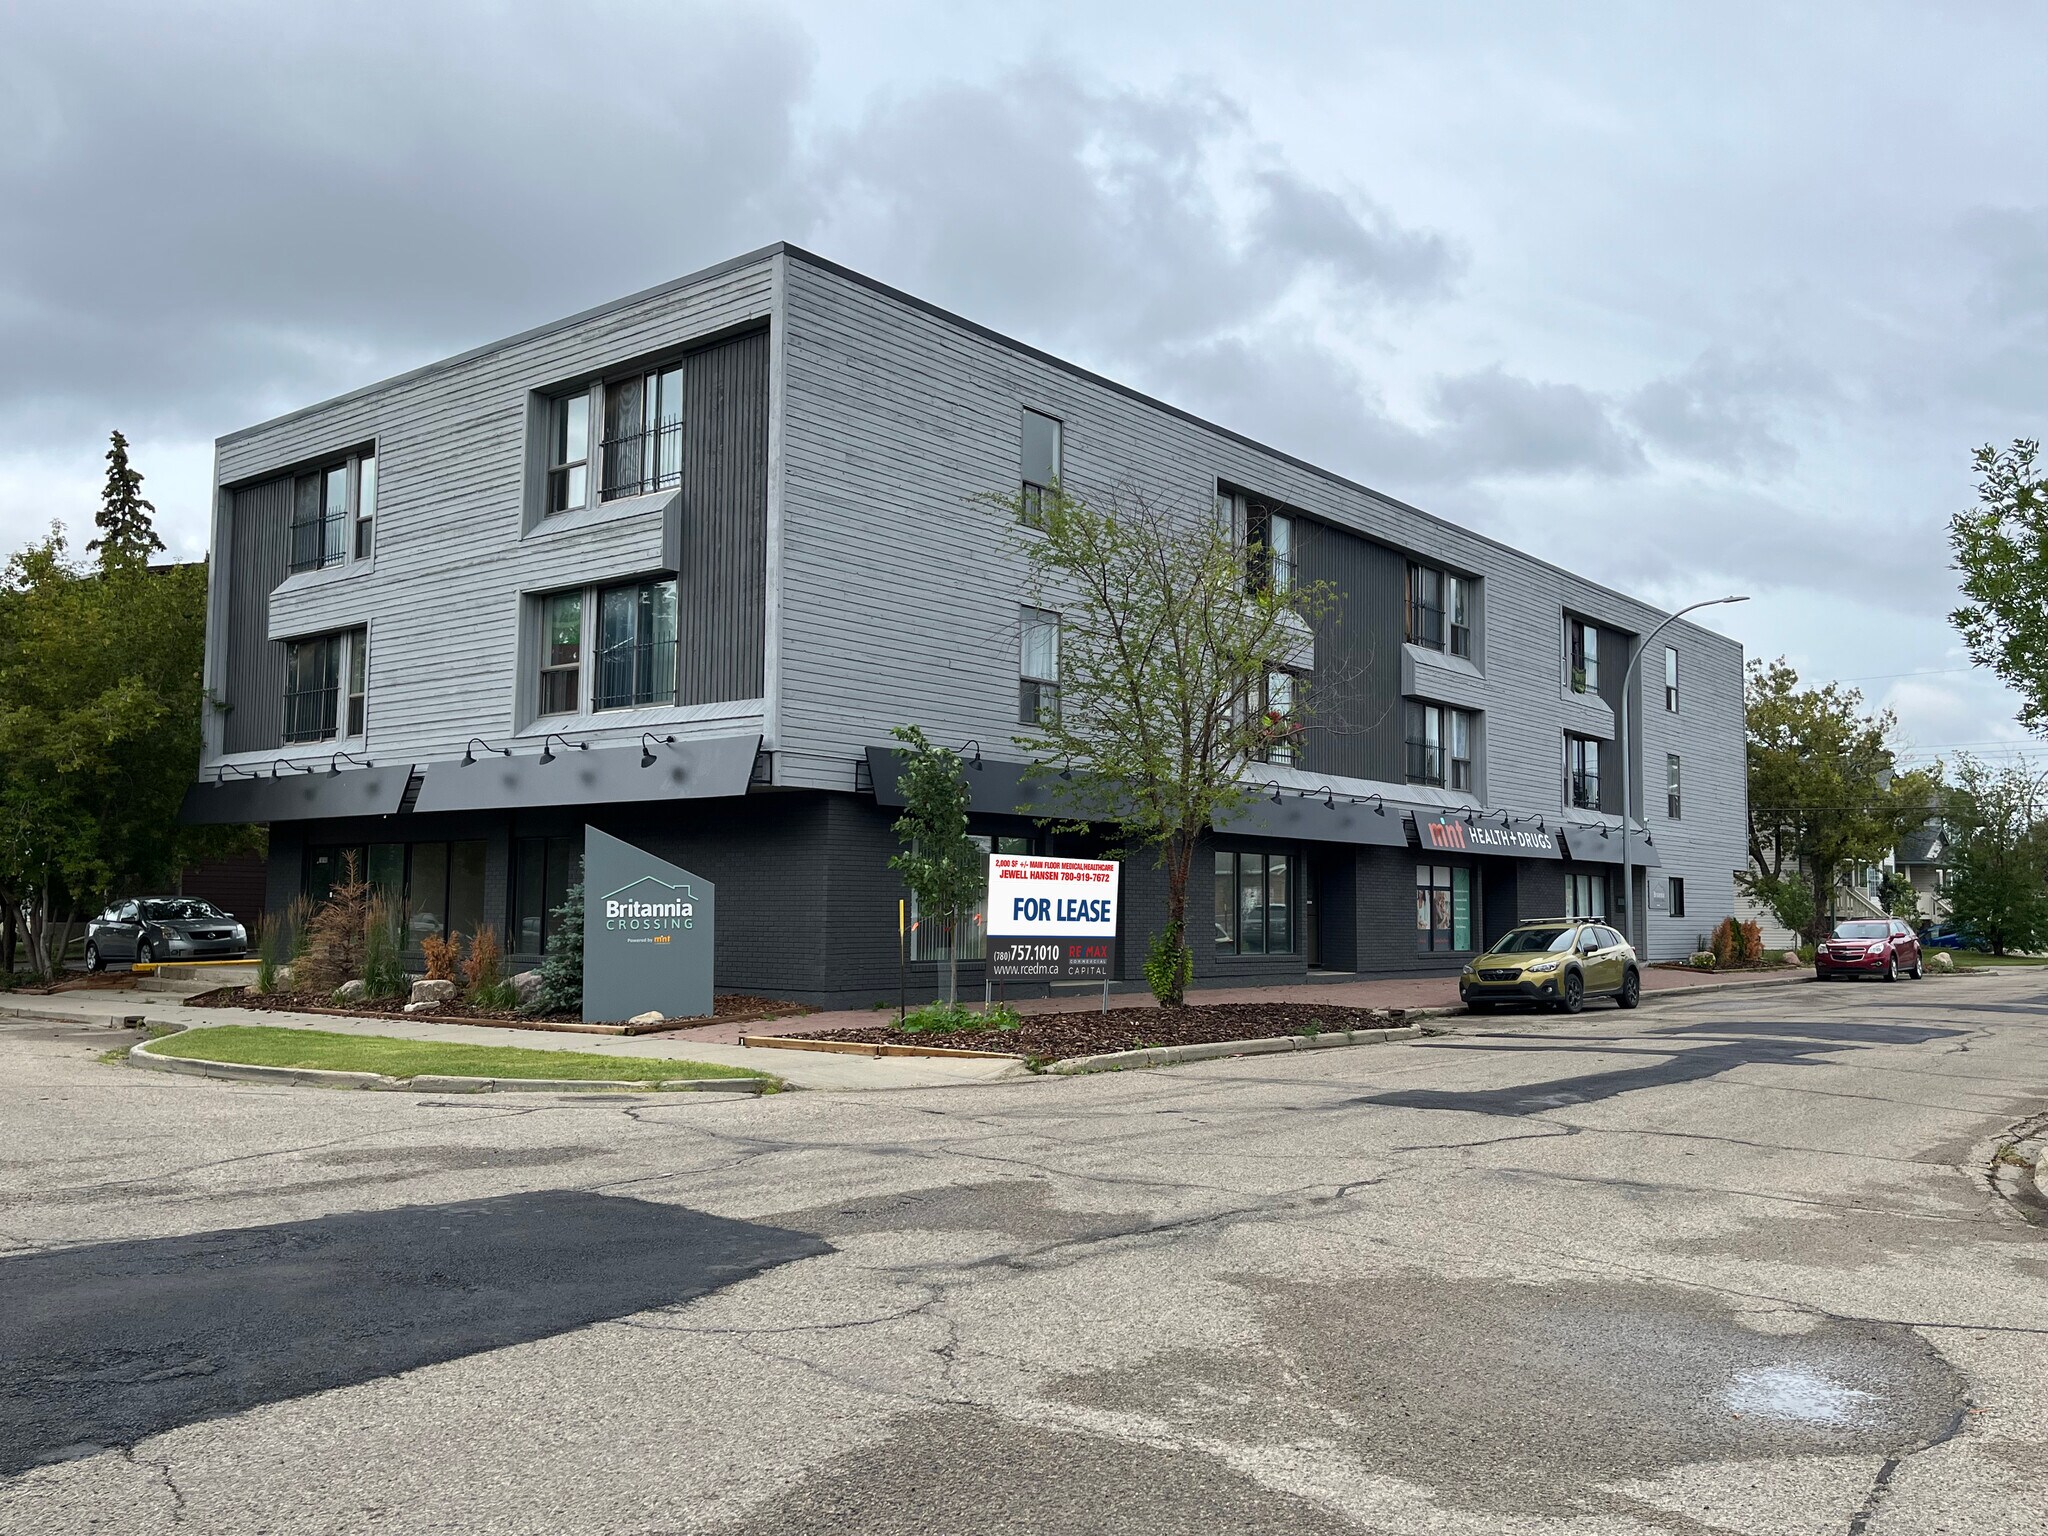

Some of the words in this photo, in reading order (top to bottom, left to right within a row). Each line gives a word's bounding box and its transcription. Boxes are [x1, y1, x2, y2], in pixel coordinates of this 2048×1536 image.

[1428, 817, 1466, 849] mint
[995, 860, 1010, 868] 2,000
[999, 870, 1028, 879] JEWELL
[1030, 871, 1058, 880] HANSEN
[1060, 872, 1110, 882] 780-919-7672
[606, 898, 693, 918] Britannia
[1013, 897, 1051, 921] FOR
[1056, 899, 1111, 922] LEASE
[606, 918, 693, 930] CROSSING
[654, 934, 671, 943] mint
[1069, 945, 1107, 958] RE/MAX
[993, 963, 1059, 975] www.rcedm.ca
[1068, 966, 1107, 975] CAPITAL
